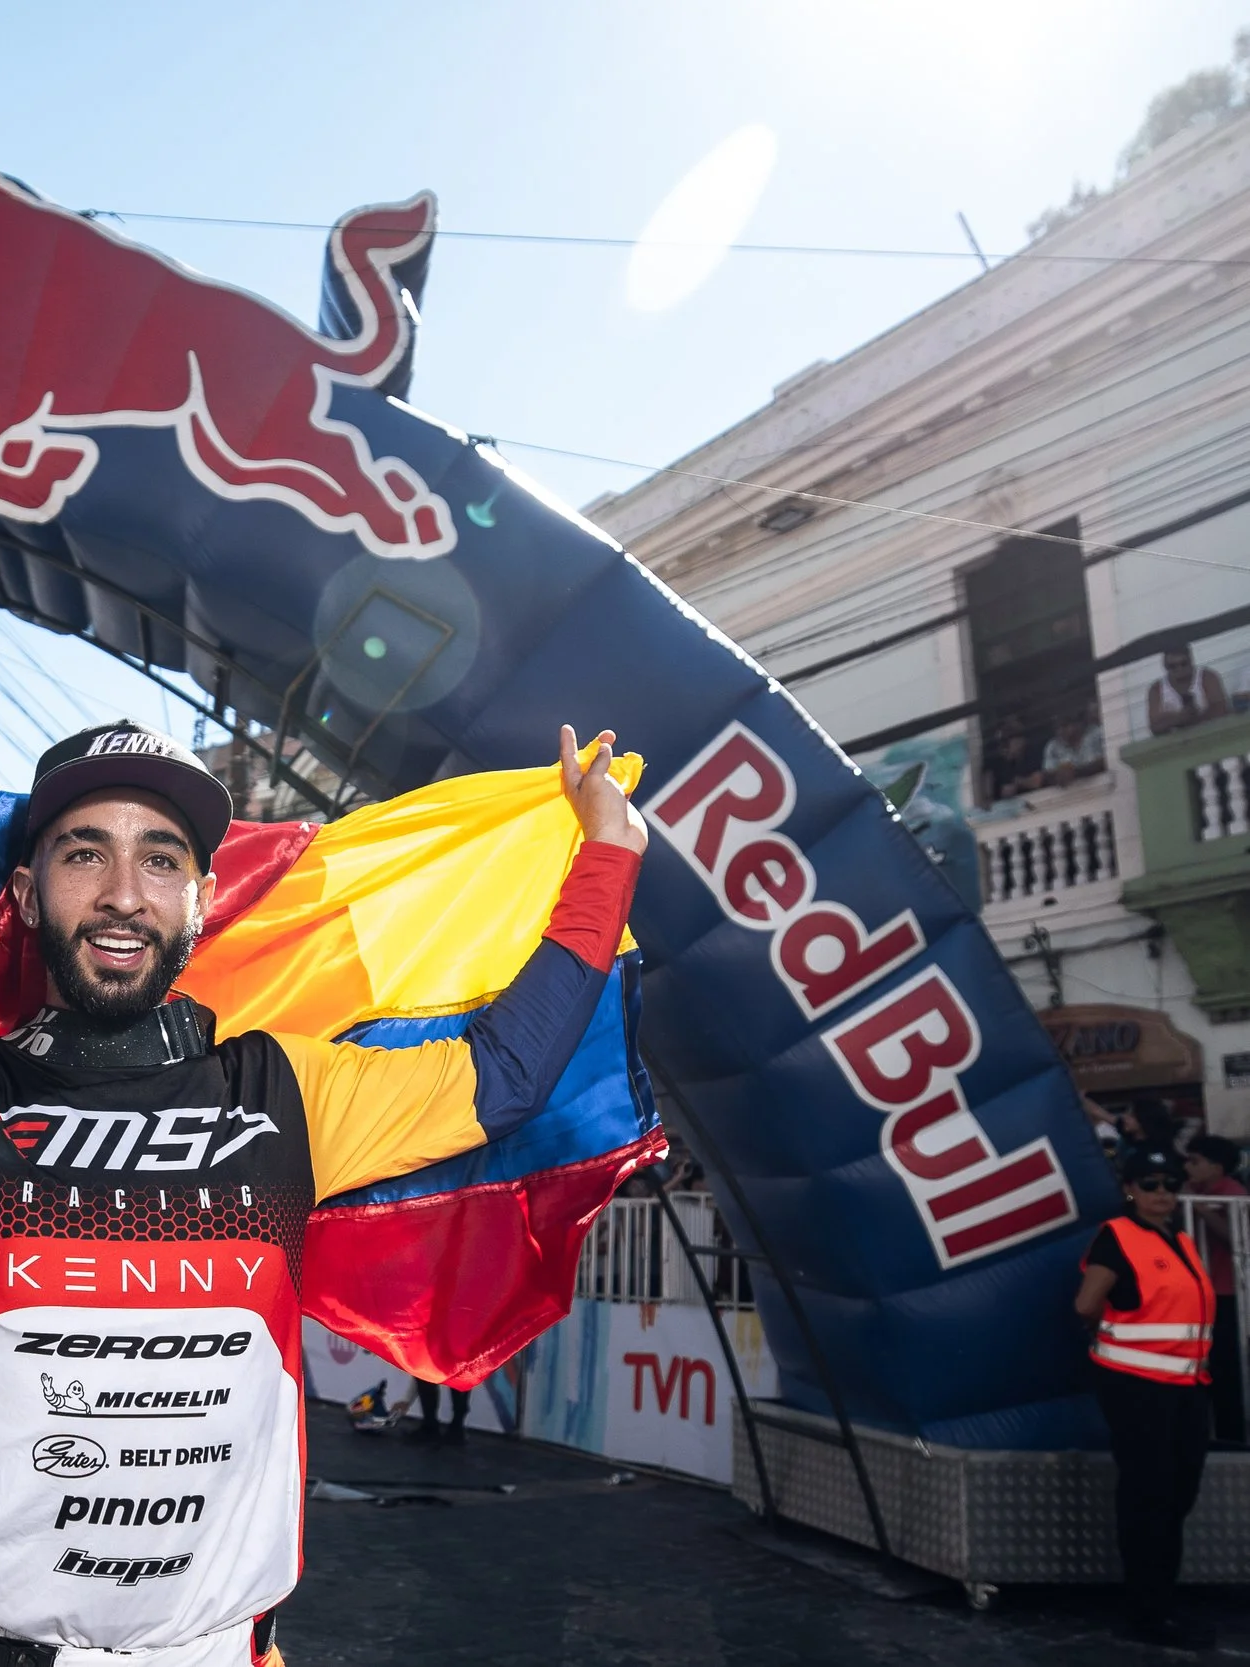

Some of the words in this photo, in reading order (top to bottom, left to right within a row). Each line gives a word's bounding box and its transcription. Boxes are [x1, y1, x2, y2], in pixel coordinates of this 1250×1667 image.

[642, 722, 926, 1021] Red
[820, 964, 1078, 1269] Bull
[22, 1180, 253, 1211] RACING
[8, 1252, 265, 1294] KENNY
[94, 1387, 231, 1408] MICHELIN
[119, 1448, 171, 1467] BELT
[175, 1443, 232, 1466] DRIVE
[55, 1494, 206, 1530] pinion
[53, 1547, 194, 1586] hope
